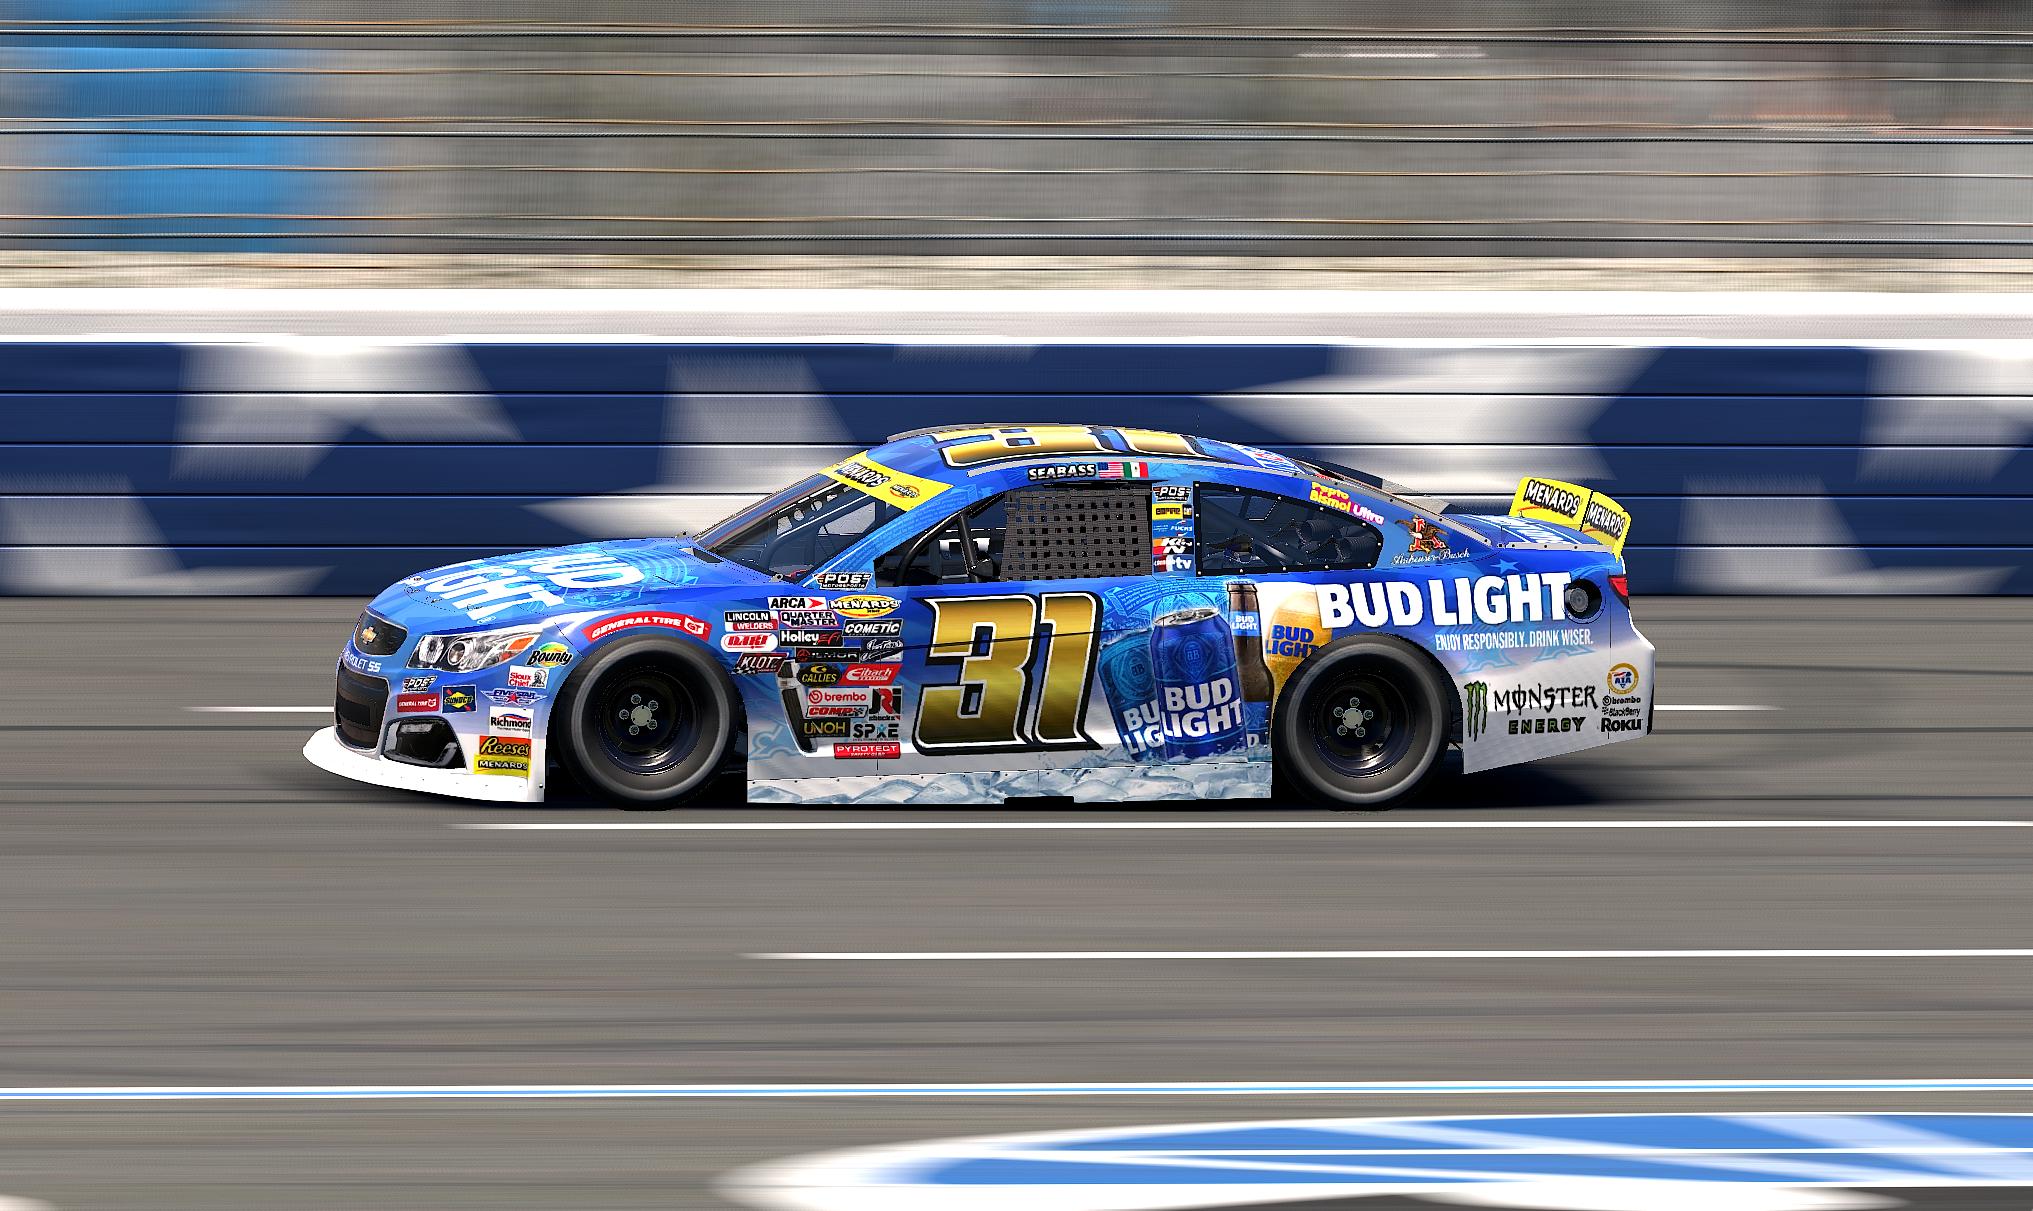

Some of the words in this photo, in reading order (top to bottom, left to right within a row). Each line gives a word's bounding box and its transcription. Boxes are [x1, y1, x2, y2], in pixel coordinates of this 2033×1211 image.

[834, 462, 891, 487] MENARDS
[1028, 464, 1096, 480] SEABASS
[1311, 481, 1350, 500] Pepto
[1523, 480, 1581, 518] MENARDS
[1310, 490, 1352, 512] Bismol
[1352, 503, 1385, 525] Ultra
[1585, 502, 1626, 540] MENARDS
[824, 574, 863, 584] POS
[770, 598, 806, 609] ARCA
[829, 600, 901, 610] MENARDS
[1315, 581, 1424, 628] BUD
[1428, 572, 1572, 626] LIGHT
[727, 612, 769, 621] LINCOLN
[782, 611, 833, 622] QUARTER
[791, 618, 836, 627] MASTER
[1235, 614, 1254, 623] BUD
[591, 617, 651, 638] GENERAL
[652, 617, 682, 627] TIRE
[736, 622, 774, 630] WELDERS
[844, 623, 900, 633] COMETIC
[1231, 622, 1258, 631] LIGHT
[781, 630, 820, 646] Holley
[1271, 624, 1315, 643] BUD
[1435, 634, 1462, 651] ENJOY
[1463, 631, 1528, 651] RESPONSIBLY.
[1529, 631, 1559, 648] DRINK
[1560, 629, 1594, 646] WISER.
[526, 650, 573, 667] Bounty
[367, 661, 382, 672] SS
[913, 591, 1100, 753] 31
[510, 671, 532, 680] Sioux
[802, 673, 838, 683] CALLIES
[846, 667, 893, 680] Eibach
[508, 679, 530, 687] Chief
[444, 695, 474, 705] SUNOCO
[493, 689, 513, 697] FIVE
[516, 691, 536, 699] STAR
[825, 692, 867, 702] brembo
[1164, 677, 1232, 712] BUD
[1494, 683, 1599, 715] MONSTER
[1611, 696, 1642, 705] brembo
[1122, 700, 1160, 731] BU
[1163, 697, 1243, 738] LIGHT
[1609, 707, 1641, 717] BlackBerry
[491, 716, 532, 729] Richmond
[803, 721, 846, 735] UNOH
[1508, 717, 1587, 734] ENERGY
[1124, 727, 1164, 754] LIG
[478, 760, 528, 771] MENARDS
